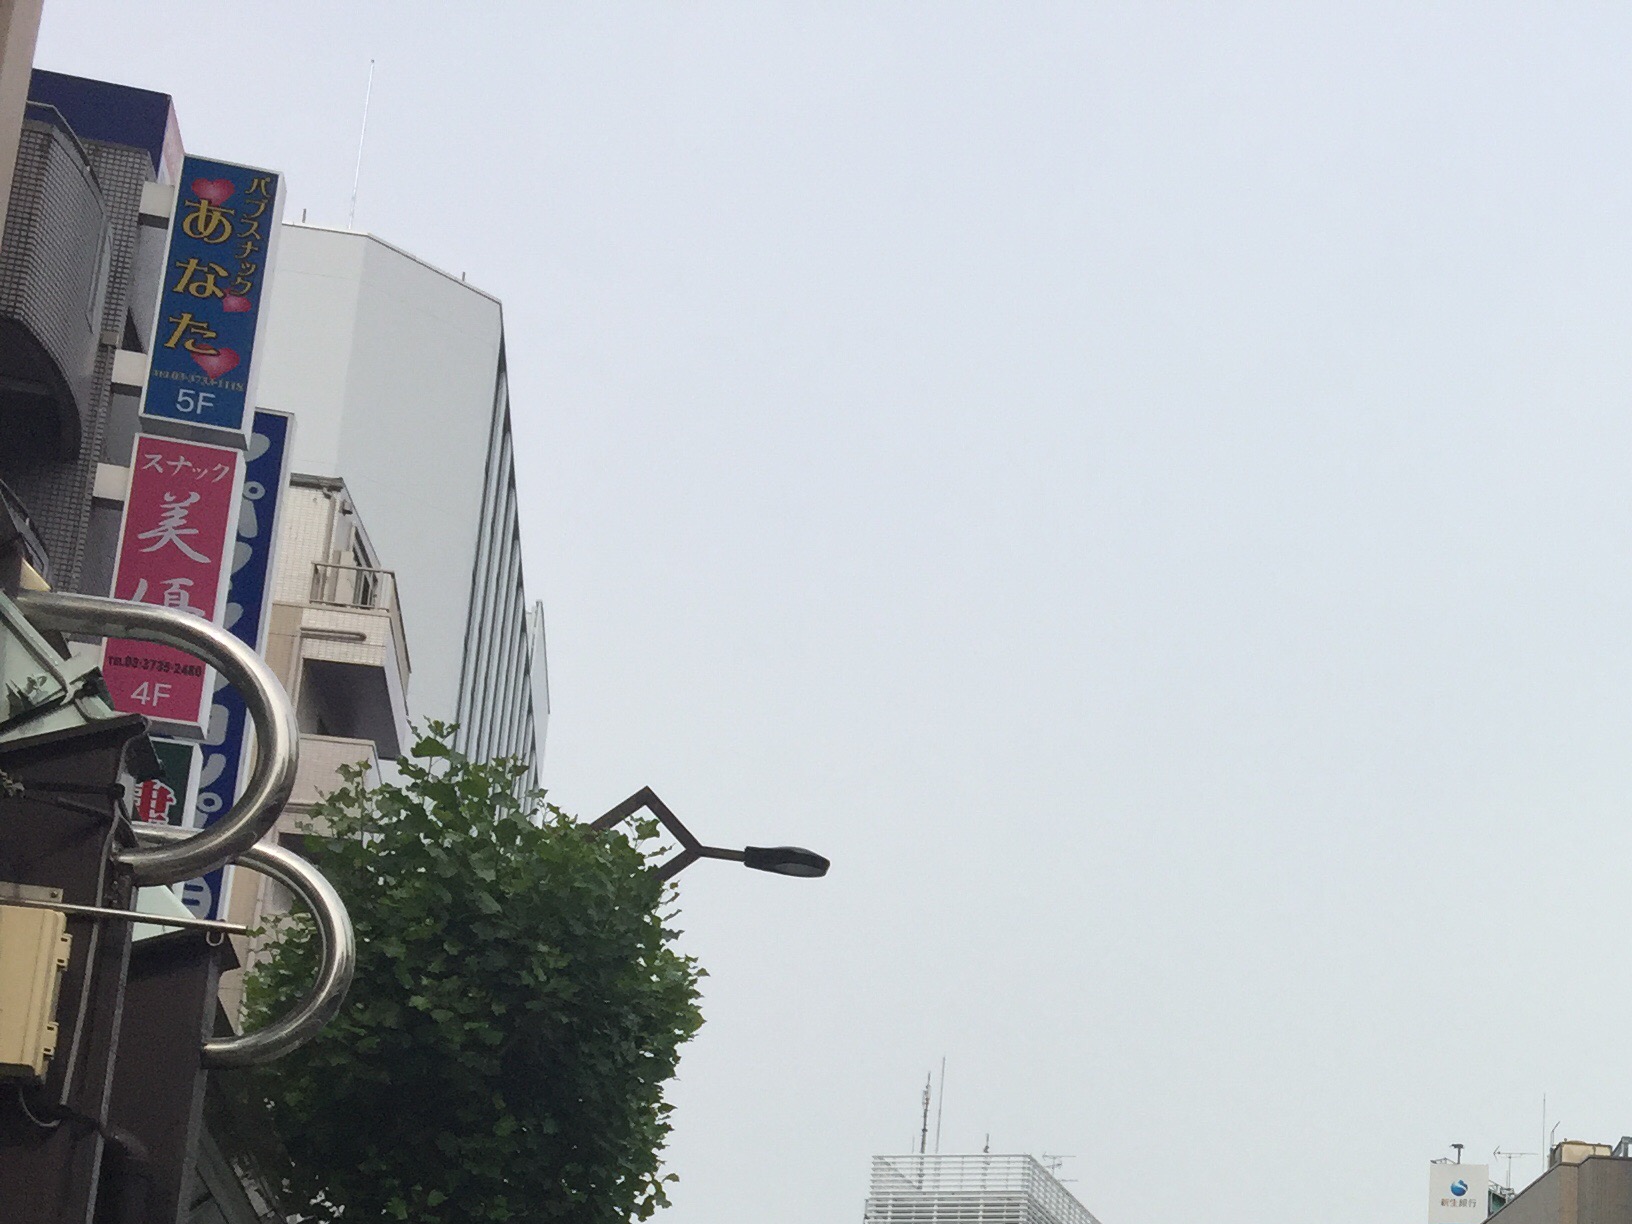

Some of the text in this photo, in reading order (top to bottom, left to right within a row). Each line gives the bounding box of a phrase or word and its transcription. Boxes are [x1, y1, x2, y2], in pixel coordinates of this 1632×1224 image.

[228, 176, 272, 296] パブスナック
[163, 196, 236, 356] あなた
[175, 388, 216, 414] 5F
[142, 453, 230, 483] スナック
[130, 681, 172, 707] 4F
